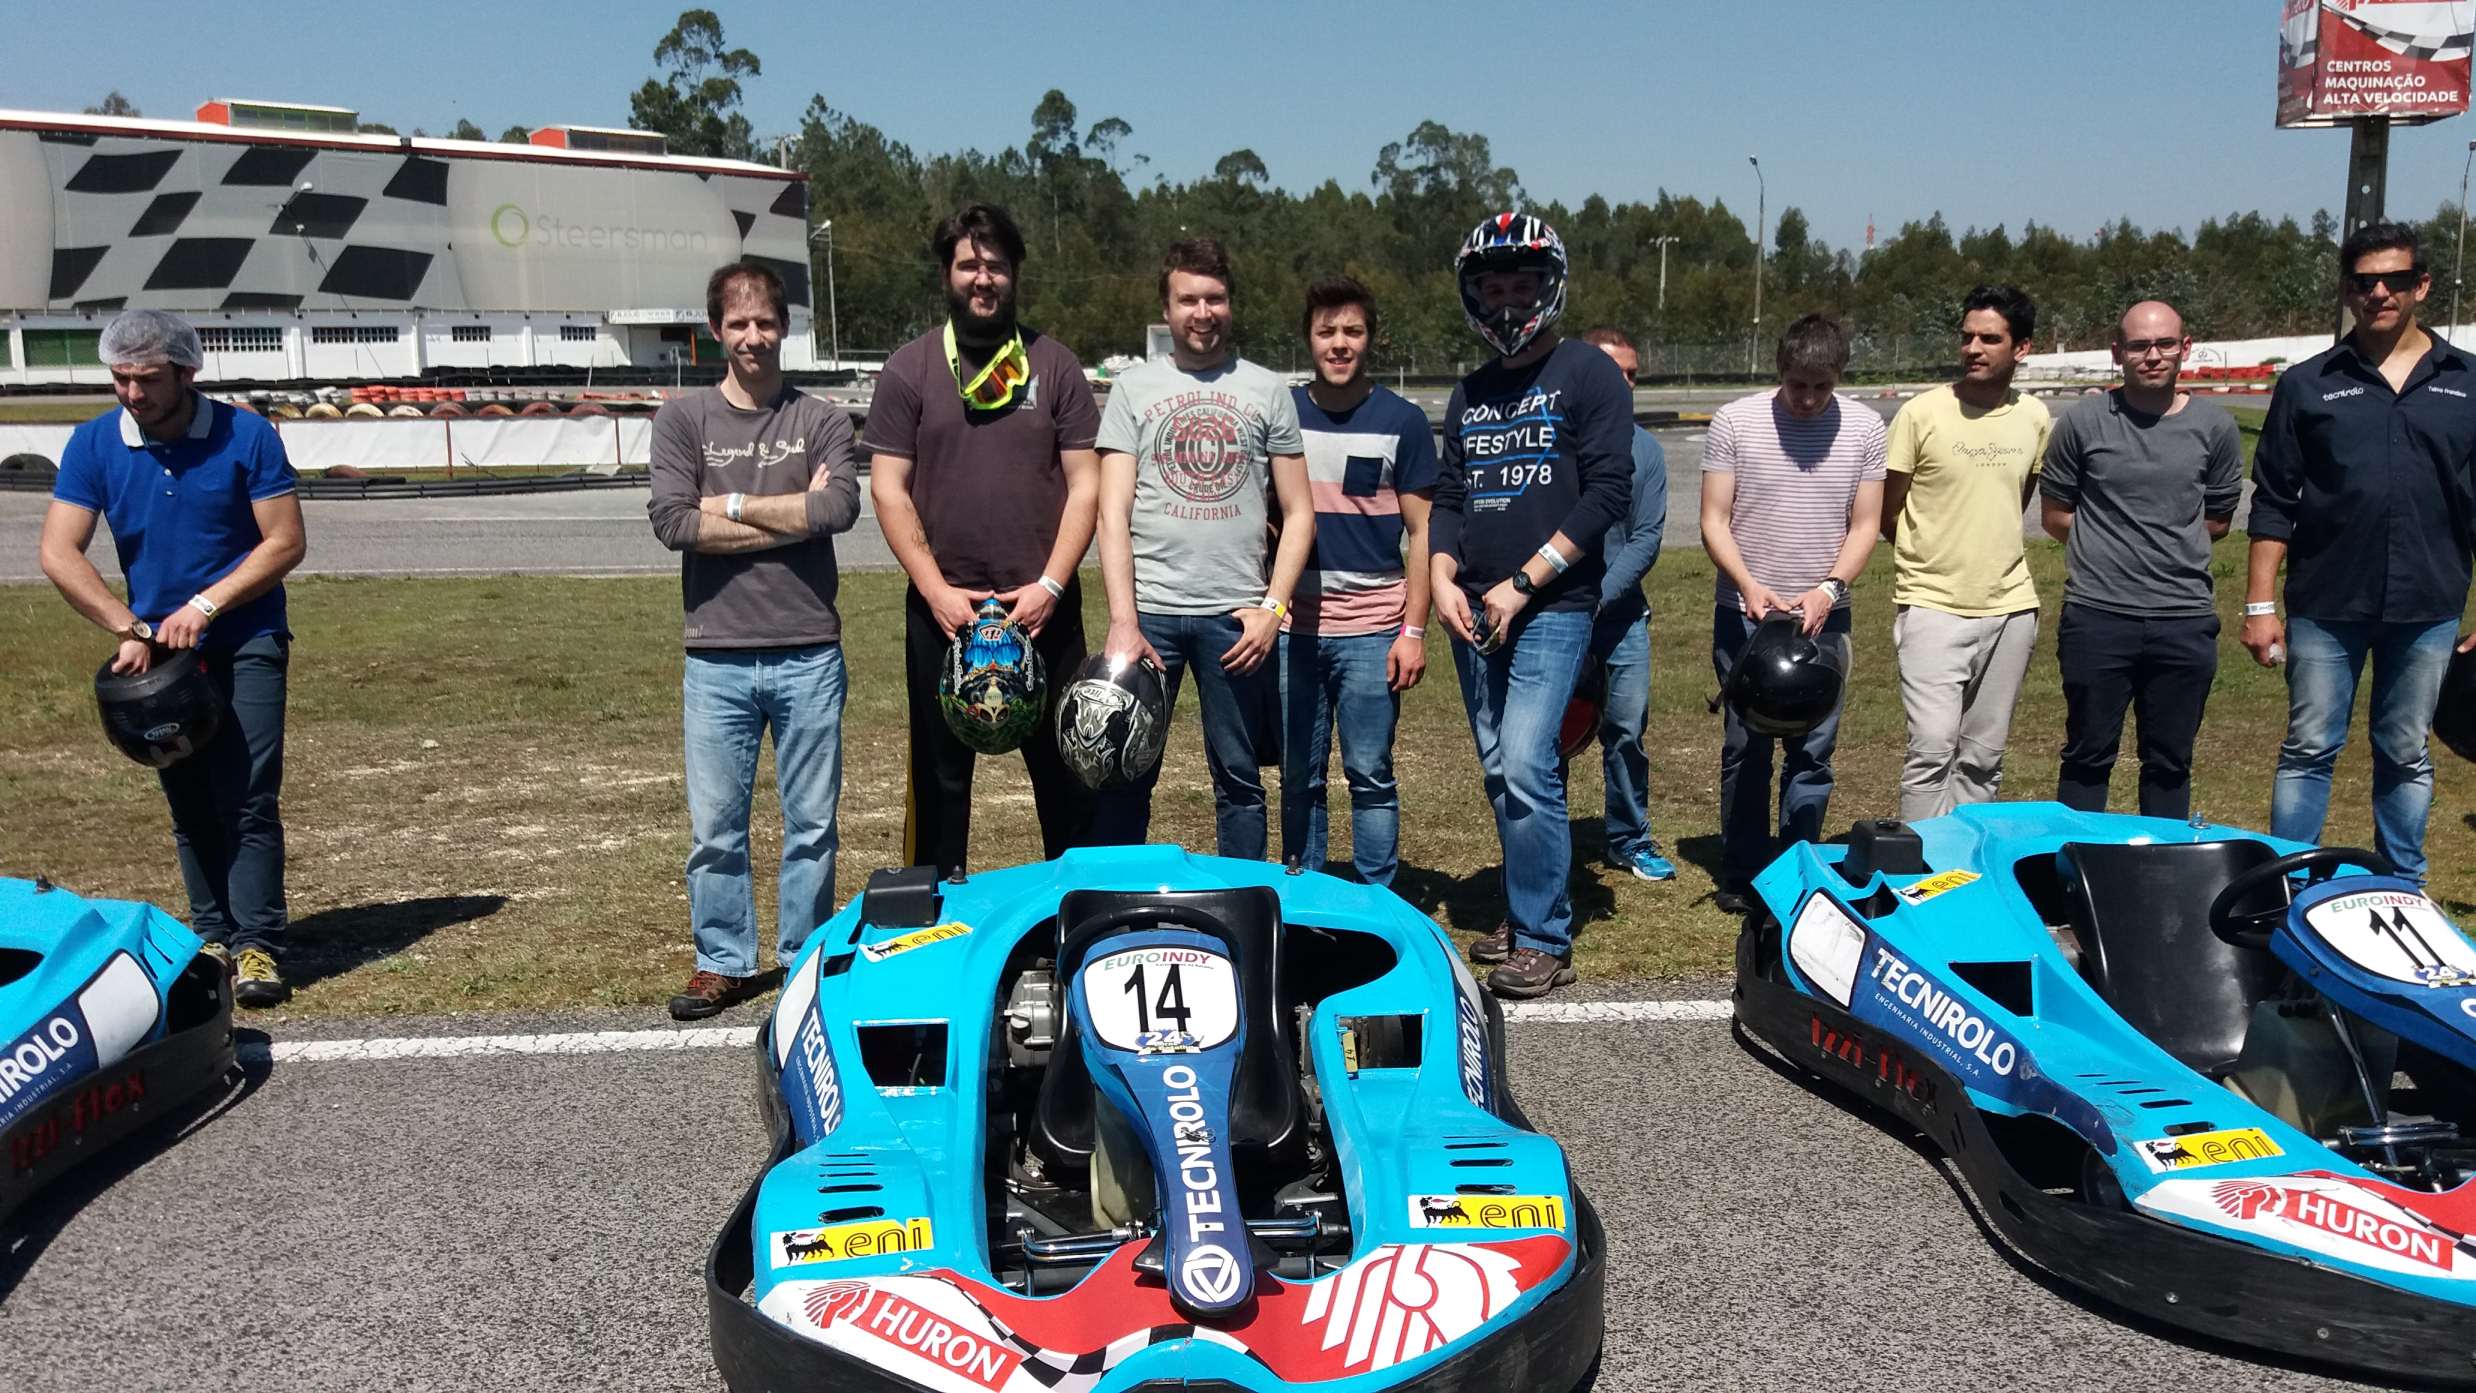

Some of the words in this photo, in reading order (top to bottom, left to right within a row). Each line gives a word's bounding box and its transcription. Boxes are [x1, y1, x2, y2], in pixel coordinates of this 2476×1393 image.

[2325, 74, 2426, 90] MAQUINAÇÃO
[2326, 60, 2392, 72] CENTROS
[2323, 93, 2360, 104] ALTA
[2363, 91, 2459, 104] VELOCIDADE
[535, 214, 708, 250] Steersman
[1210, 391, 1238, 410] IND
[1461, 390, 1561, 425] CONCEPT
[1500, 465, 1552, 487] 1978
[1163, 501, 1242, 521] CALIFORNIA
[2331, 895, 2423, 913] EUROINDY
[912, 925, 971, 946] eni
[2368, 906, 2447, 969] 11
[1104, 951, 1212, 971] EUROINDY
[1124, 963, 1191, 1032] 14
[1870, 947, 2017, 1076] TECNIROLO
[0, 1017, 79, 1104] IROLO
[801, 1007, 842, 1135] TECNIROL
[1460, 996, 1485, 1110] ECNIROLO
[1162, 1065, 1225, 1242] TECNIROLO
[2203, 1127, 2275, 1164] eni
[1479, 1195, 1554, 1228] eni
[2298, 1193, 2439, 1264] HURON
[844, 1218, 923, 1258] eni
[870, 1295, 1007, 1382] HURON
